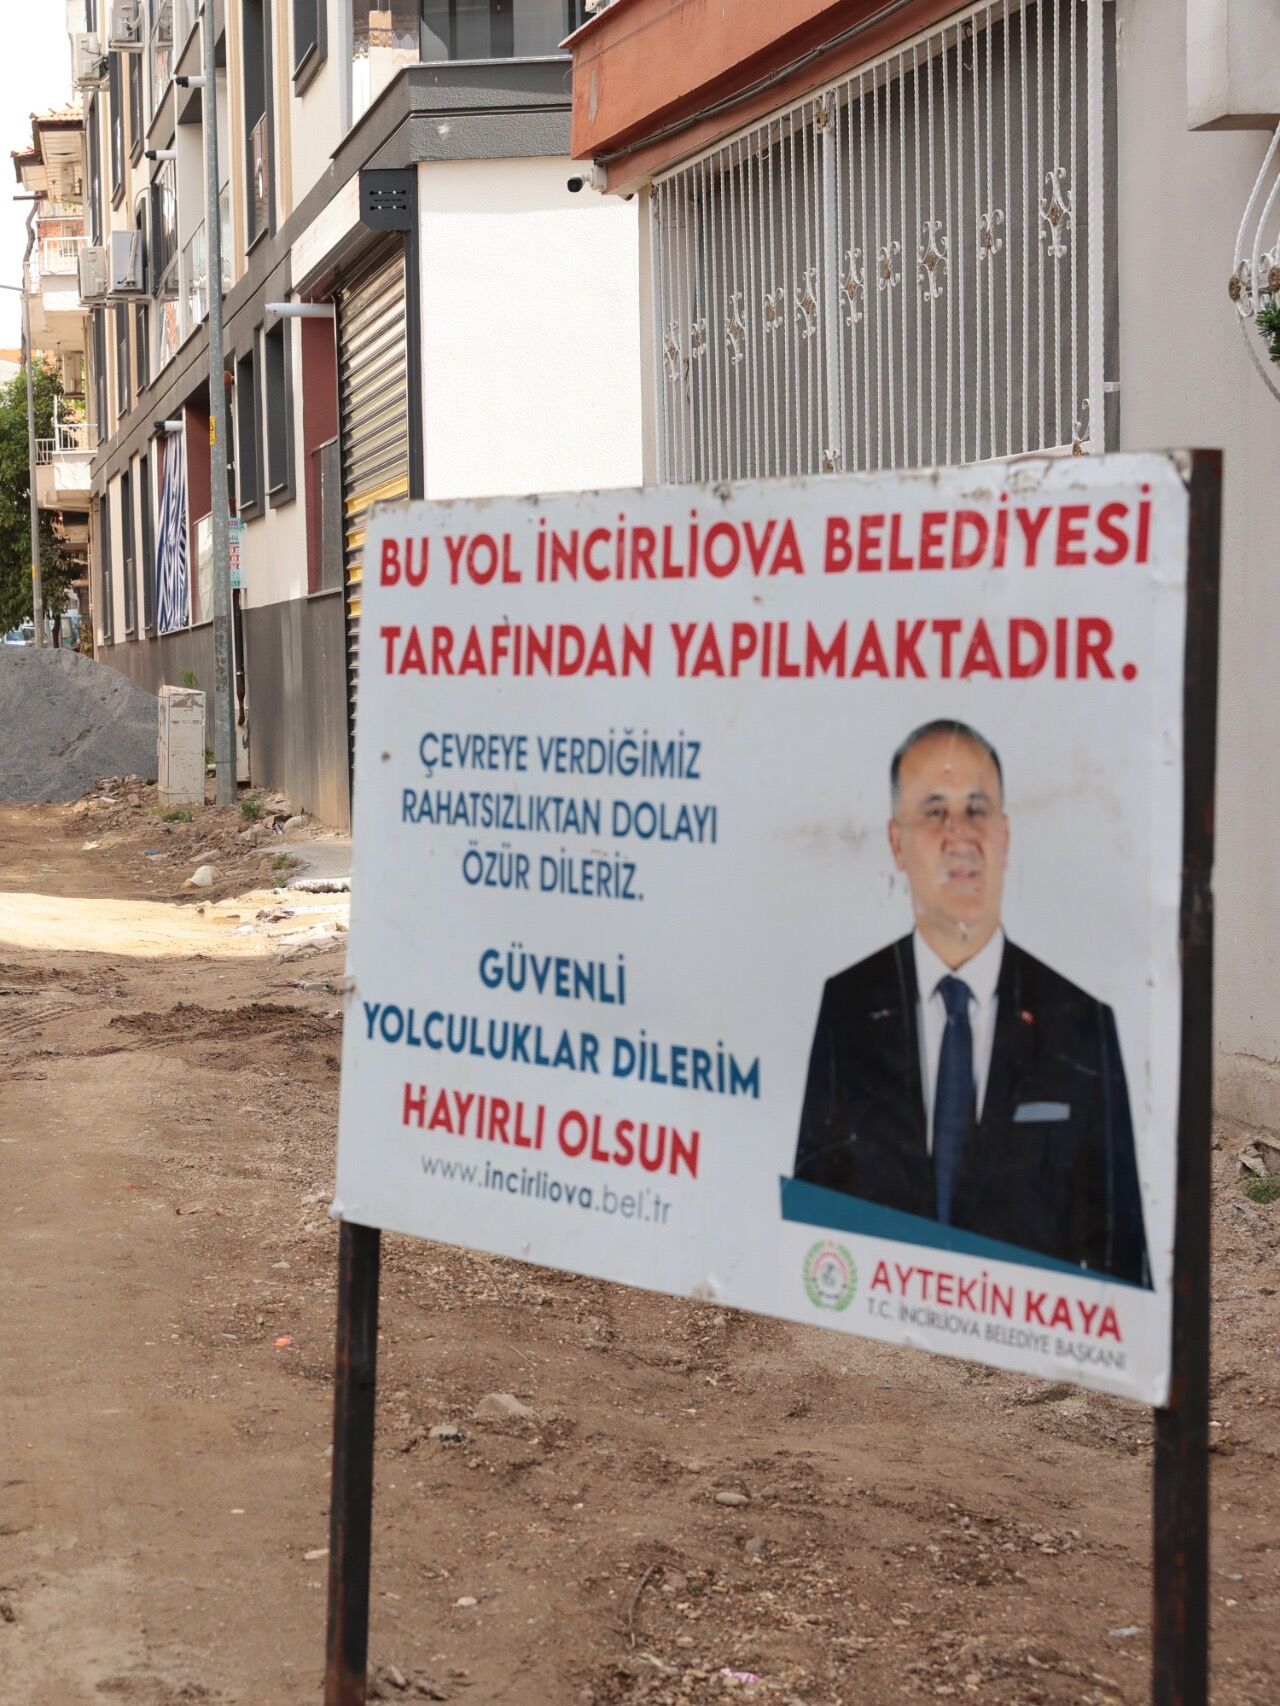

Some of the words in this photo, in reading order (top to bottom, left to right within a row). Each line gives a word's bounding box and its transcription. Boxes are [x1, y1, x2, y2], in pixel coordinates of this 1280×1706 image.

[380, 537, 429, 587] BU
[444, 533, 521, 586] YOL
[536, 508, 805, 583] İNCİRLİOVA
[824, 483, 1152, 573] BELEDİYESİ
[380, 622, 653, 677] TARAFINDAN
[670, 617, 1138, 681] YAPILMAKTADIR.
[420, 732, 528, 778] ÇEVREYE
[537, 728, 702, 780] VERDİĞİMİZ
[402, 789, 601, 835] RAHATSIZLIKTAN
[612, 799, 718, 844] DOLAYI
[463, 840, 530, 890] ÖZÜR
[540, 847, 644, 900] DİLERİZ.
[479, 942, 627, 1005] GÜVENLİ
[363, 1002, 600, 1074] YOLCULUKLAR
[612, 1029, 761, 1099] DİLERİM
[402, 1082, 545, 1150] HAYIRLI
[557, 1110, 700, 1179] OLSUN
[421, 1154, 672, 1225] www.incirliova.bel.tr
[867, 1297, 895, 1320] T.C.
[898, 1306, 981, 1338] İNCİRLİOVA
[984, 1323, 1051, 1355] BELEDİYE
[1054, 1338, 1127, 1370] BAŞKANI
[870, 1260, 1014, 1318] AYTEKİN
[1025, 1290, 1123, 1343] KAYA
